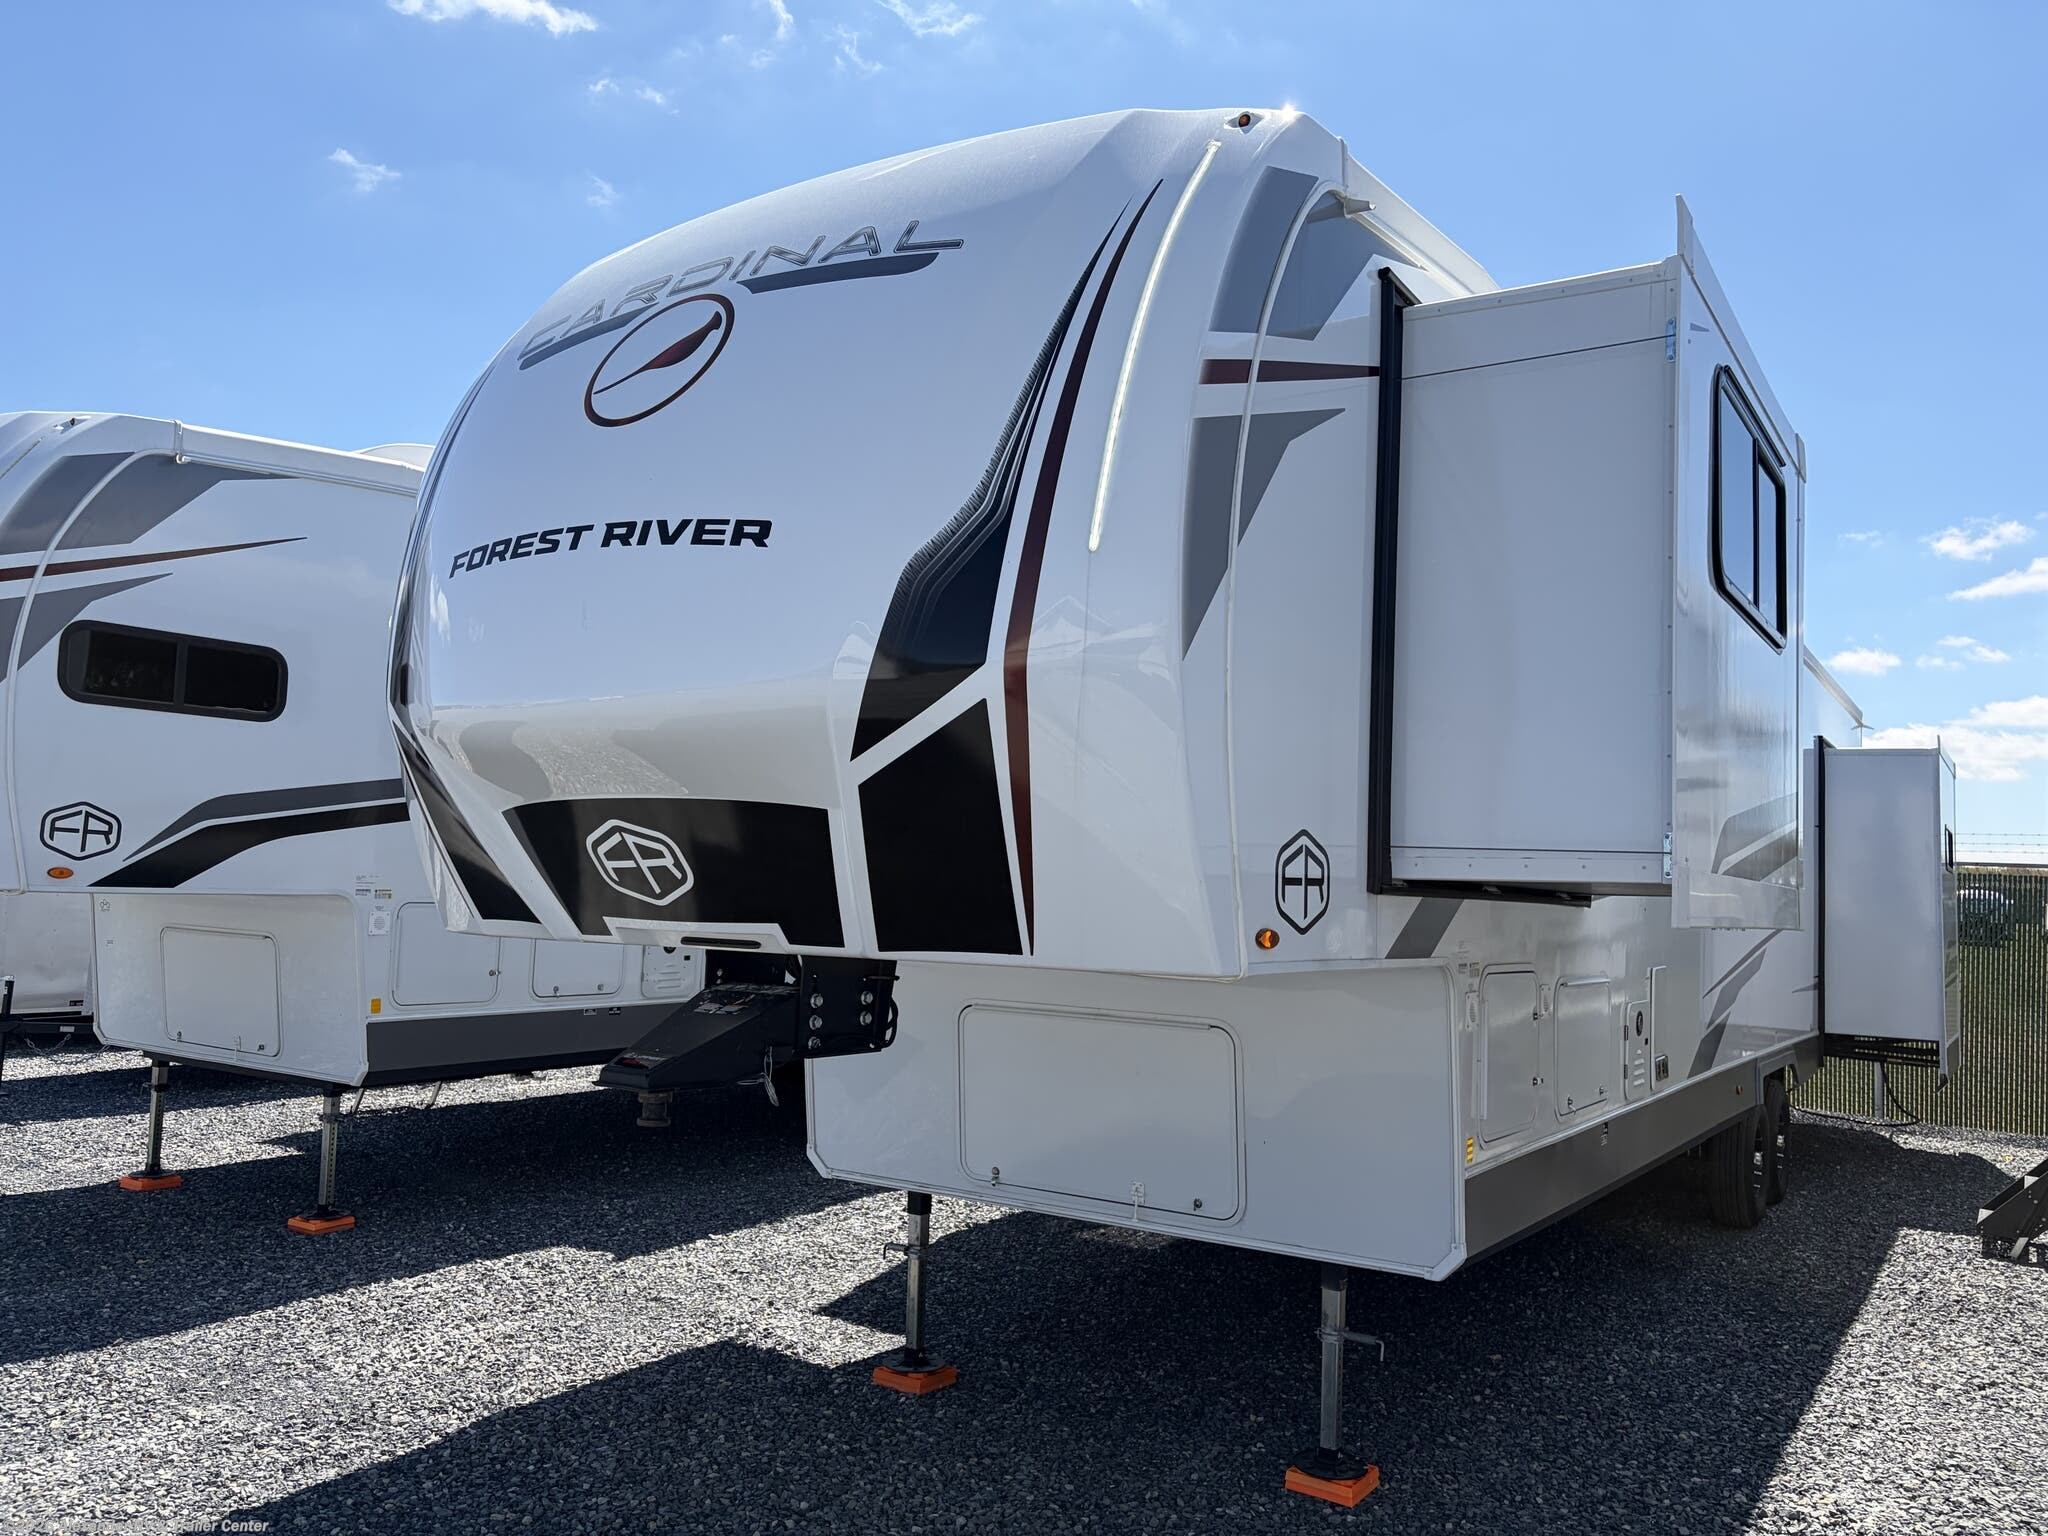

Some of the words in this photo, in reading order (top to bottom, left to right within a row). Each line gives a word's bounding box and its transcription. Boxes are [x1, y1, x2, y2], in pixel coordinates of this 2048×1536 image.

[517, 219, 965, 361] CARDINAL
[449, 524, 595, 579] FOREST
[600, 518, 773, 548] RIVER
